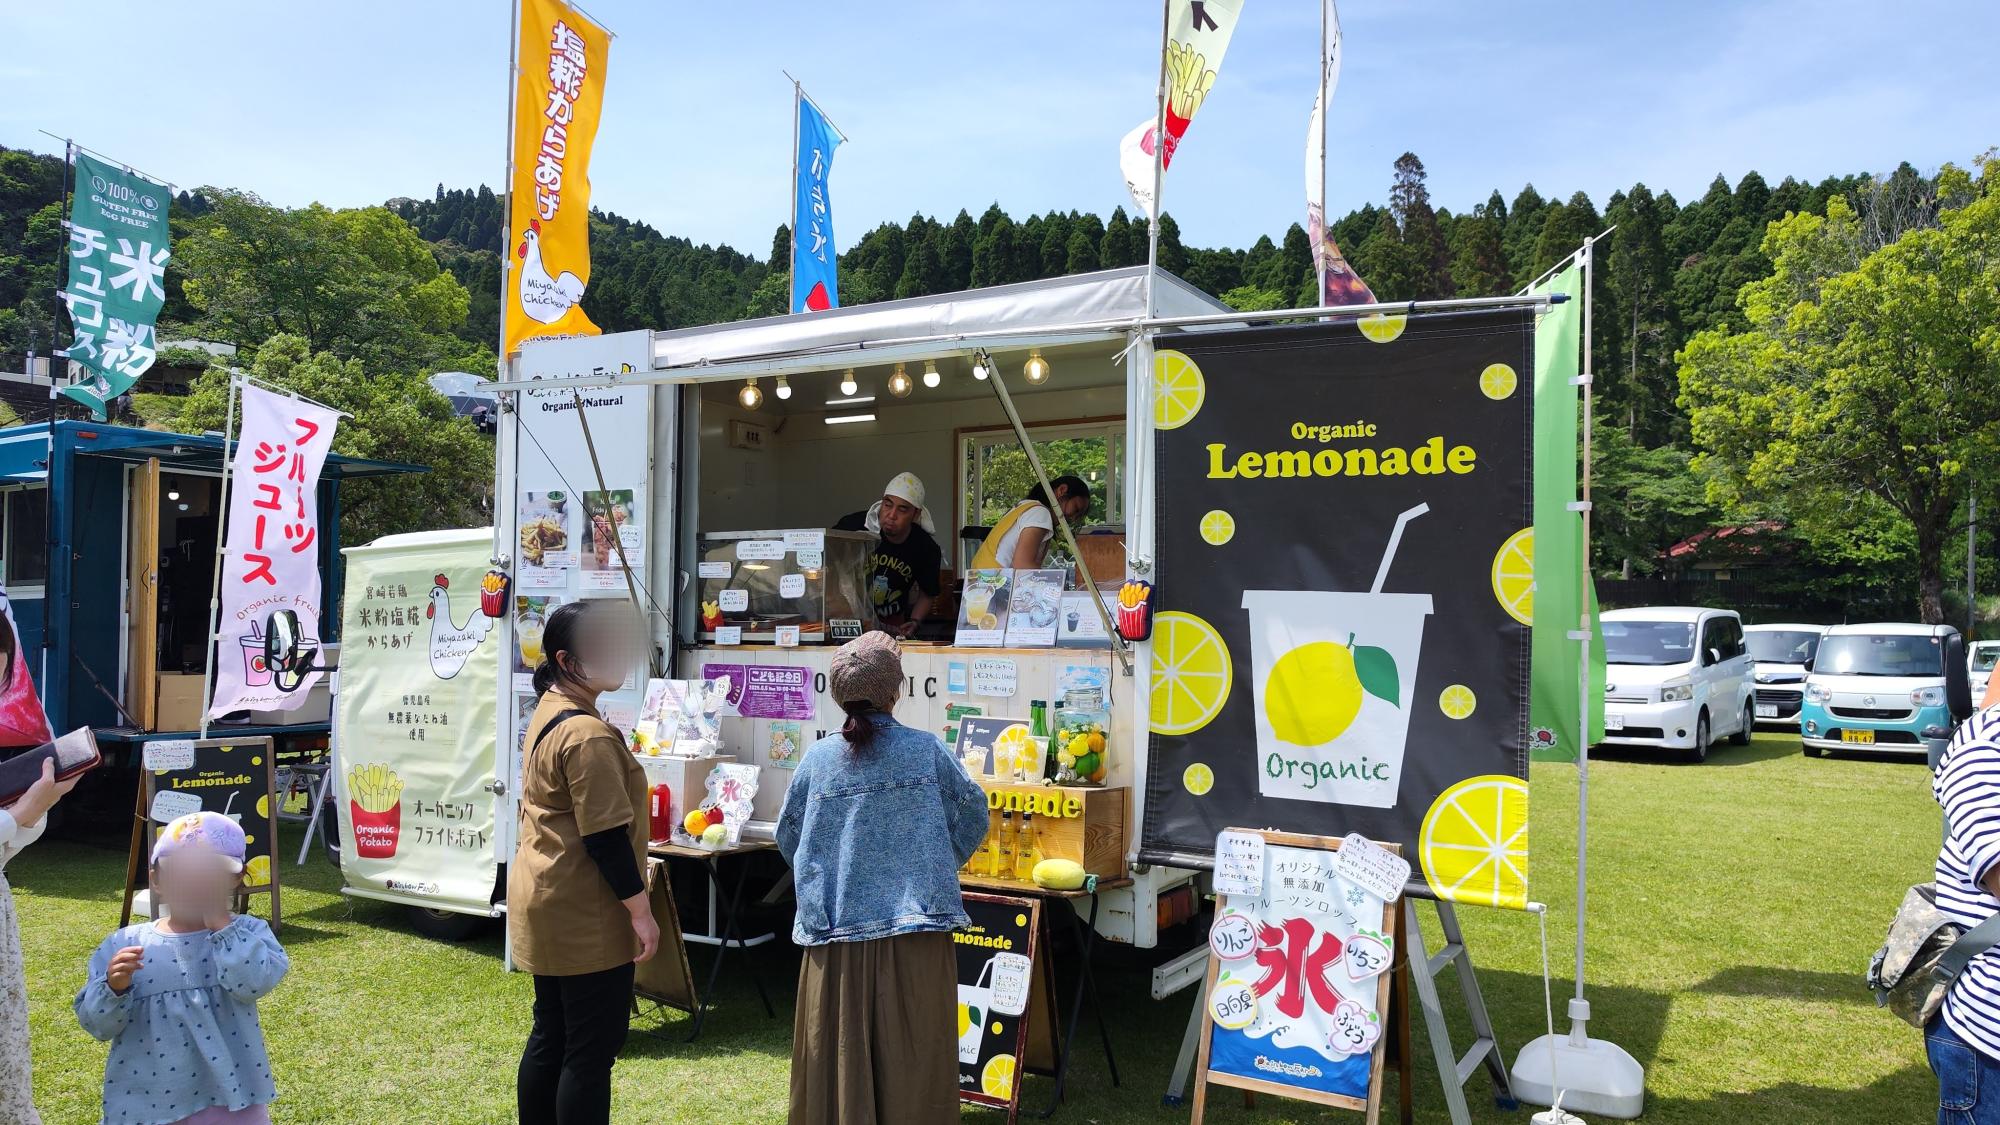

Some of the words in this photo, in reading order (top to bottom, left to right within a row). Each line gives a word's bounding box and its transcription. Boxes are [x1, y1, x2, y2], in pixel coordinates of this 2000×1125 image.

[108, 183, 140, 204] 100%
[91, 194, 130, 214] GLUTEN
[131, 208, 159, 222] FREE
[101, 207, 119, 221] EGG
[120, 216, 149, 229] FREE
[65, 226, 107, 359] チュロス
[523, 293, 567, 309] Chicken
[101, 238, 171, 378] 米粉
[542, 400, 577, 413] Organic
[586, 396, 623, 408] Natural
[1291, 420, 1377, 443] Organic
[1206, 436, 1477, 480] Lemonade
[285, 417, 319, 553] フルーツ
[242, 441, 287, 586] ジュース
[365, 584, 407, 600] 宮崎若鶏
[236, 594, 288, 620] Organic
[359, 606, 420, 628] 米粉塩糀
[367, 631, 413, 649] からあげ
[438, 630, 476, 648] Miyazaki
[834, 627, 859, 637] OPEN
[433, 649, 467, 660] Chicken
[751, 670, 801, 684] こども記念日
[408, 728, 425, 741] 使用
[199, 770, 225, 778] Organic
[1266, 751, 1390, 789] Organic
[172, 774, 252, 789] Lemonade
[413, 800, 474, 821] オーガニック
[987, 789, 1082, 818] onade
[356, 824, 395, 836] Organic
[415, 826, 487, 849] フライドポテト
[360, 836, 393, 847] Potato
[1275, 860, 1336, 880] オリジナル
[1283, 876, 1326, 893] 無添加
[1246, 893, 1359, 928] フルーツシロップ
[953, 932, 1013, 950] monade
[1216, 922, 1254, 952] りんご
[1346, 942, 1387, 971] いちご
[1252, 917, 1346, 1019] 氷
[1215, 989, 1253, 1019] 日向夏
[1337, 1015, 1366, 1044] ぶどう
